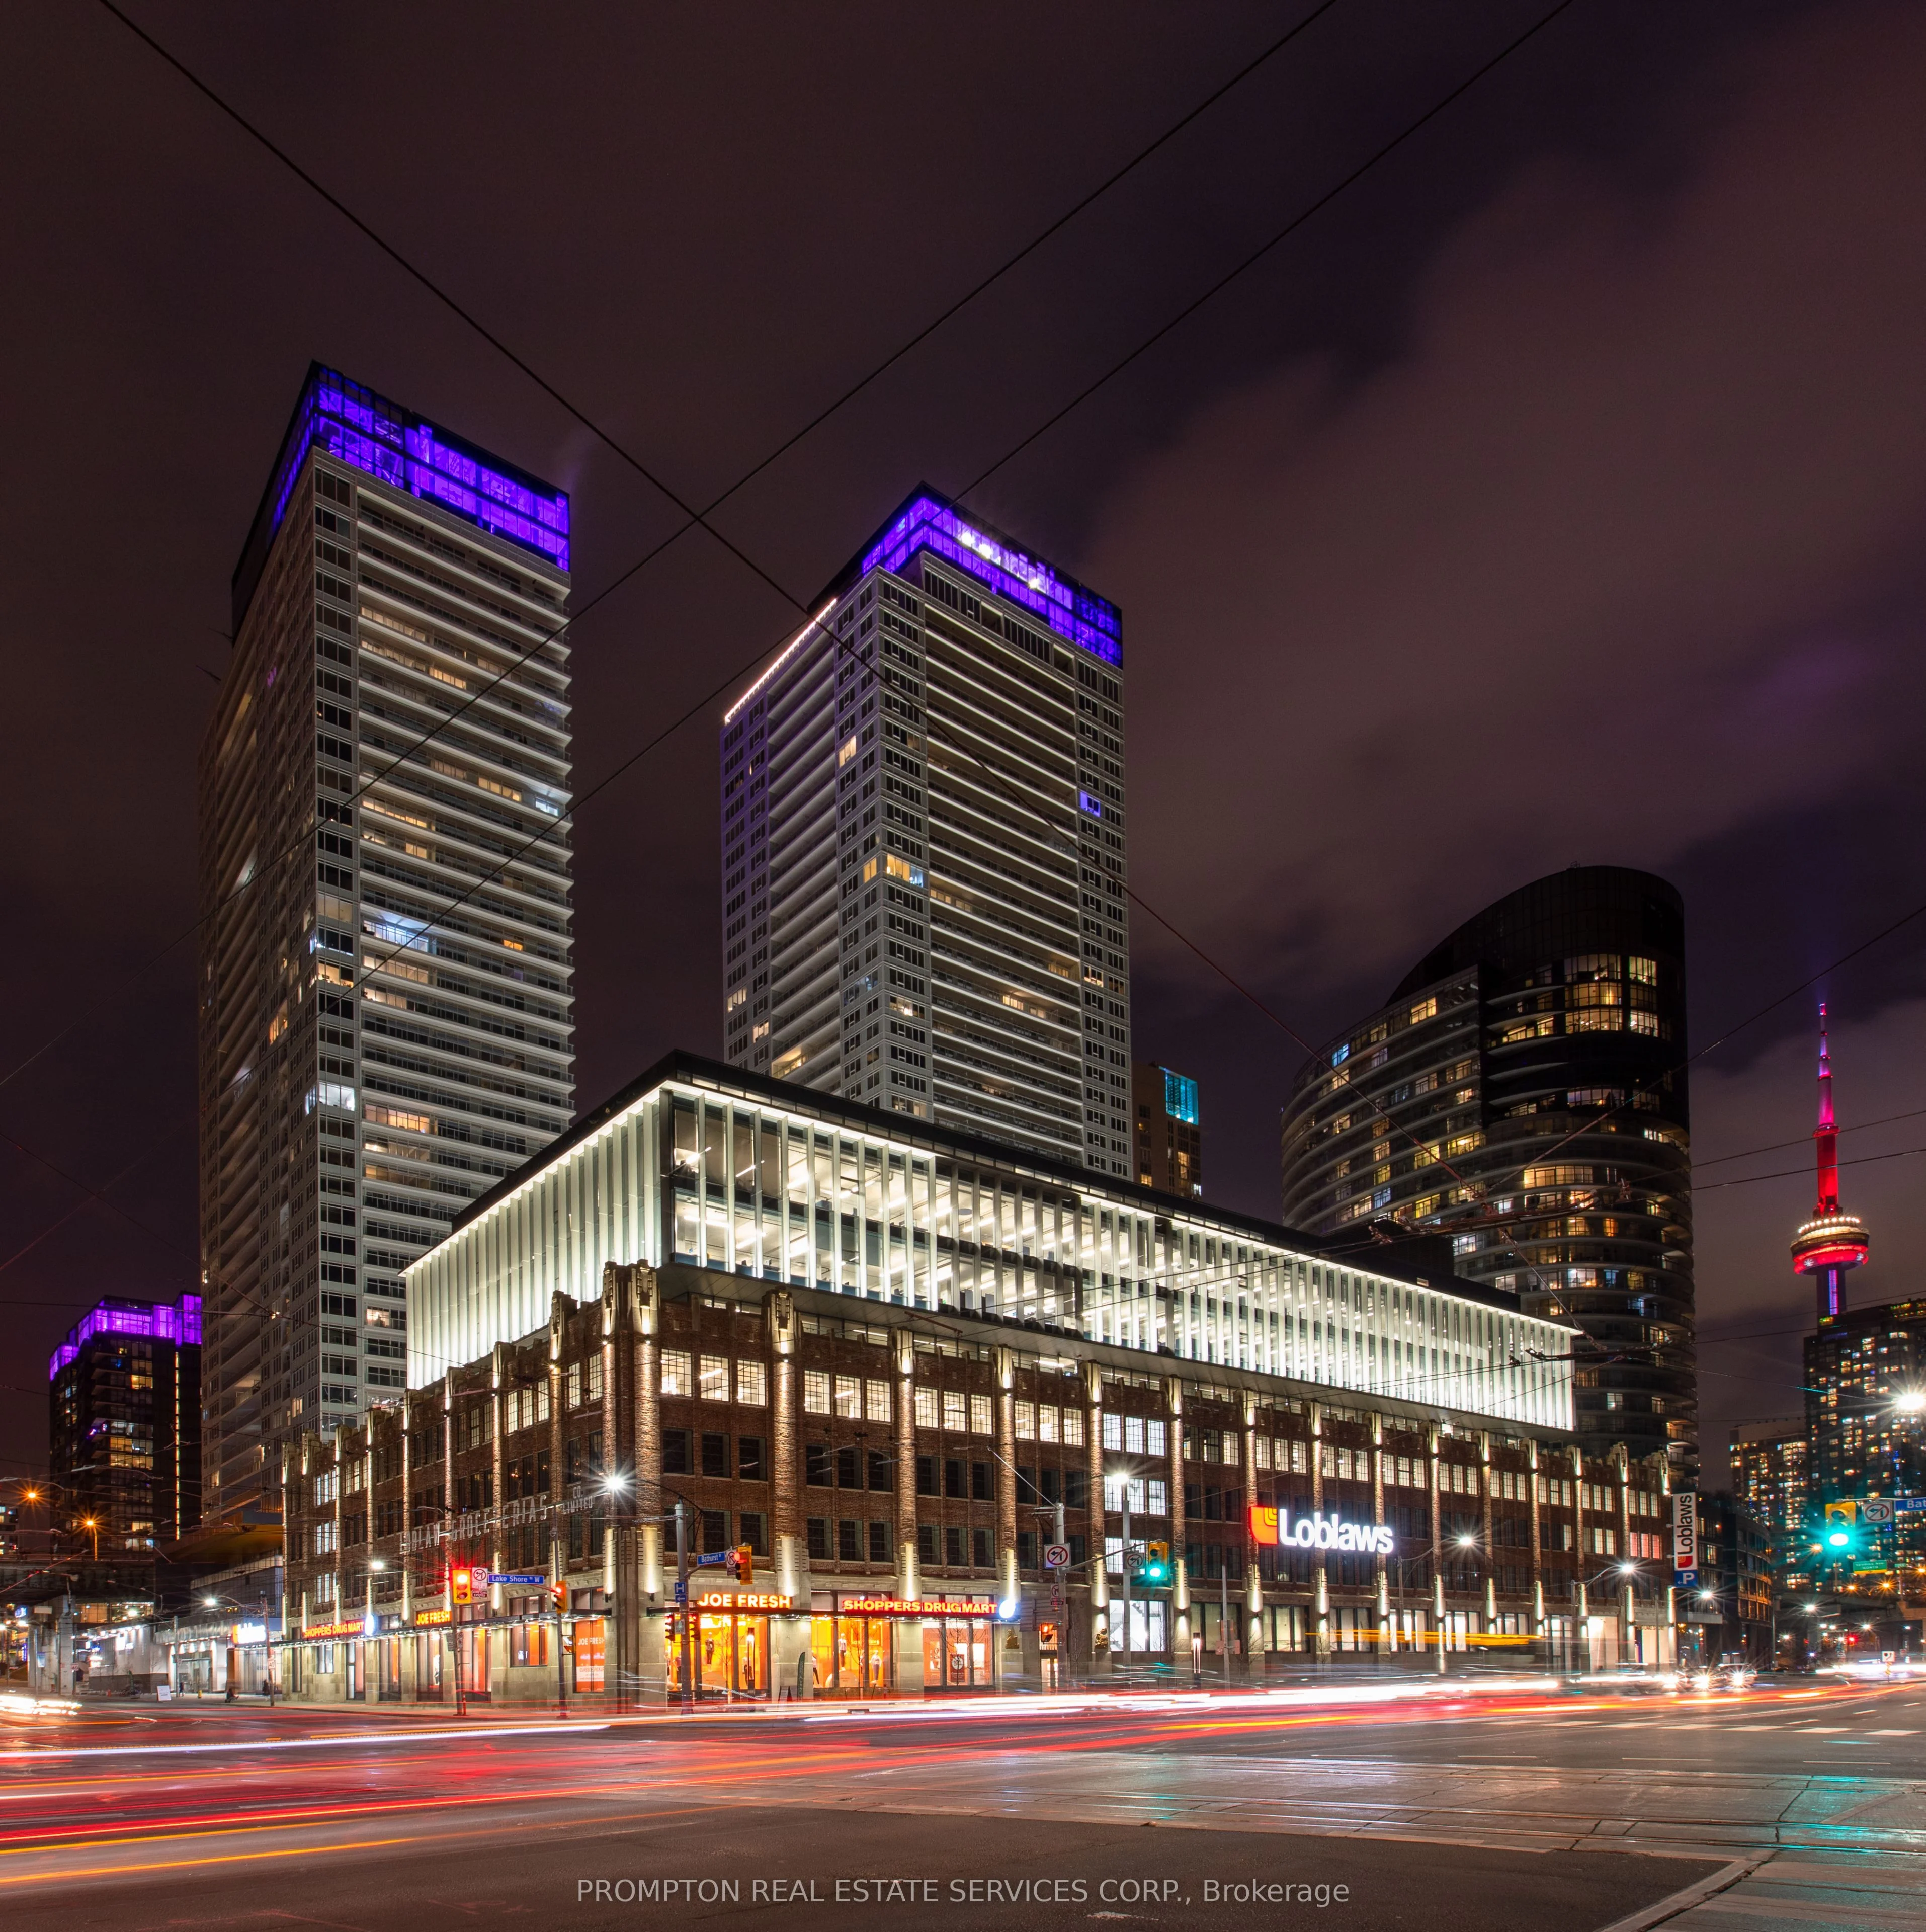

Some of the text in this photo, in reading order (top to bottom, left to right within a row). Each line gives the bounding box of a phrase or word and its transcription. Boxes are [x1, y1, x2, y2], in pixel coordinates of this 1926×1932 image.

[1279, 1509, 1393, 1553] Loblaws
[1677, 1495, 1693, 1555] Loblaws
[701, 1554, 718, 1562] Bathurst
[1683, 1573, 1694, 1584] P
[676, 1583, 684, 1593] H
[697, 1593, 790, 1608] JOE FRESH
[844, 1600, 997, 1614] SHOPPERS DRUG MART
[416, 1610, 450, 1625] JOE FRESH
[304, 1621, 364, 1638] SHOPPERS DRUG MART
